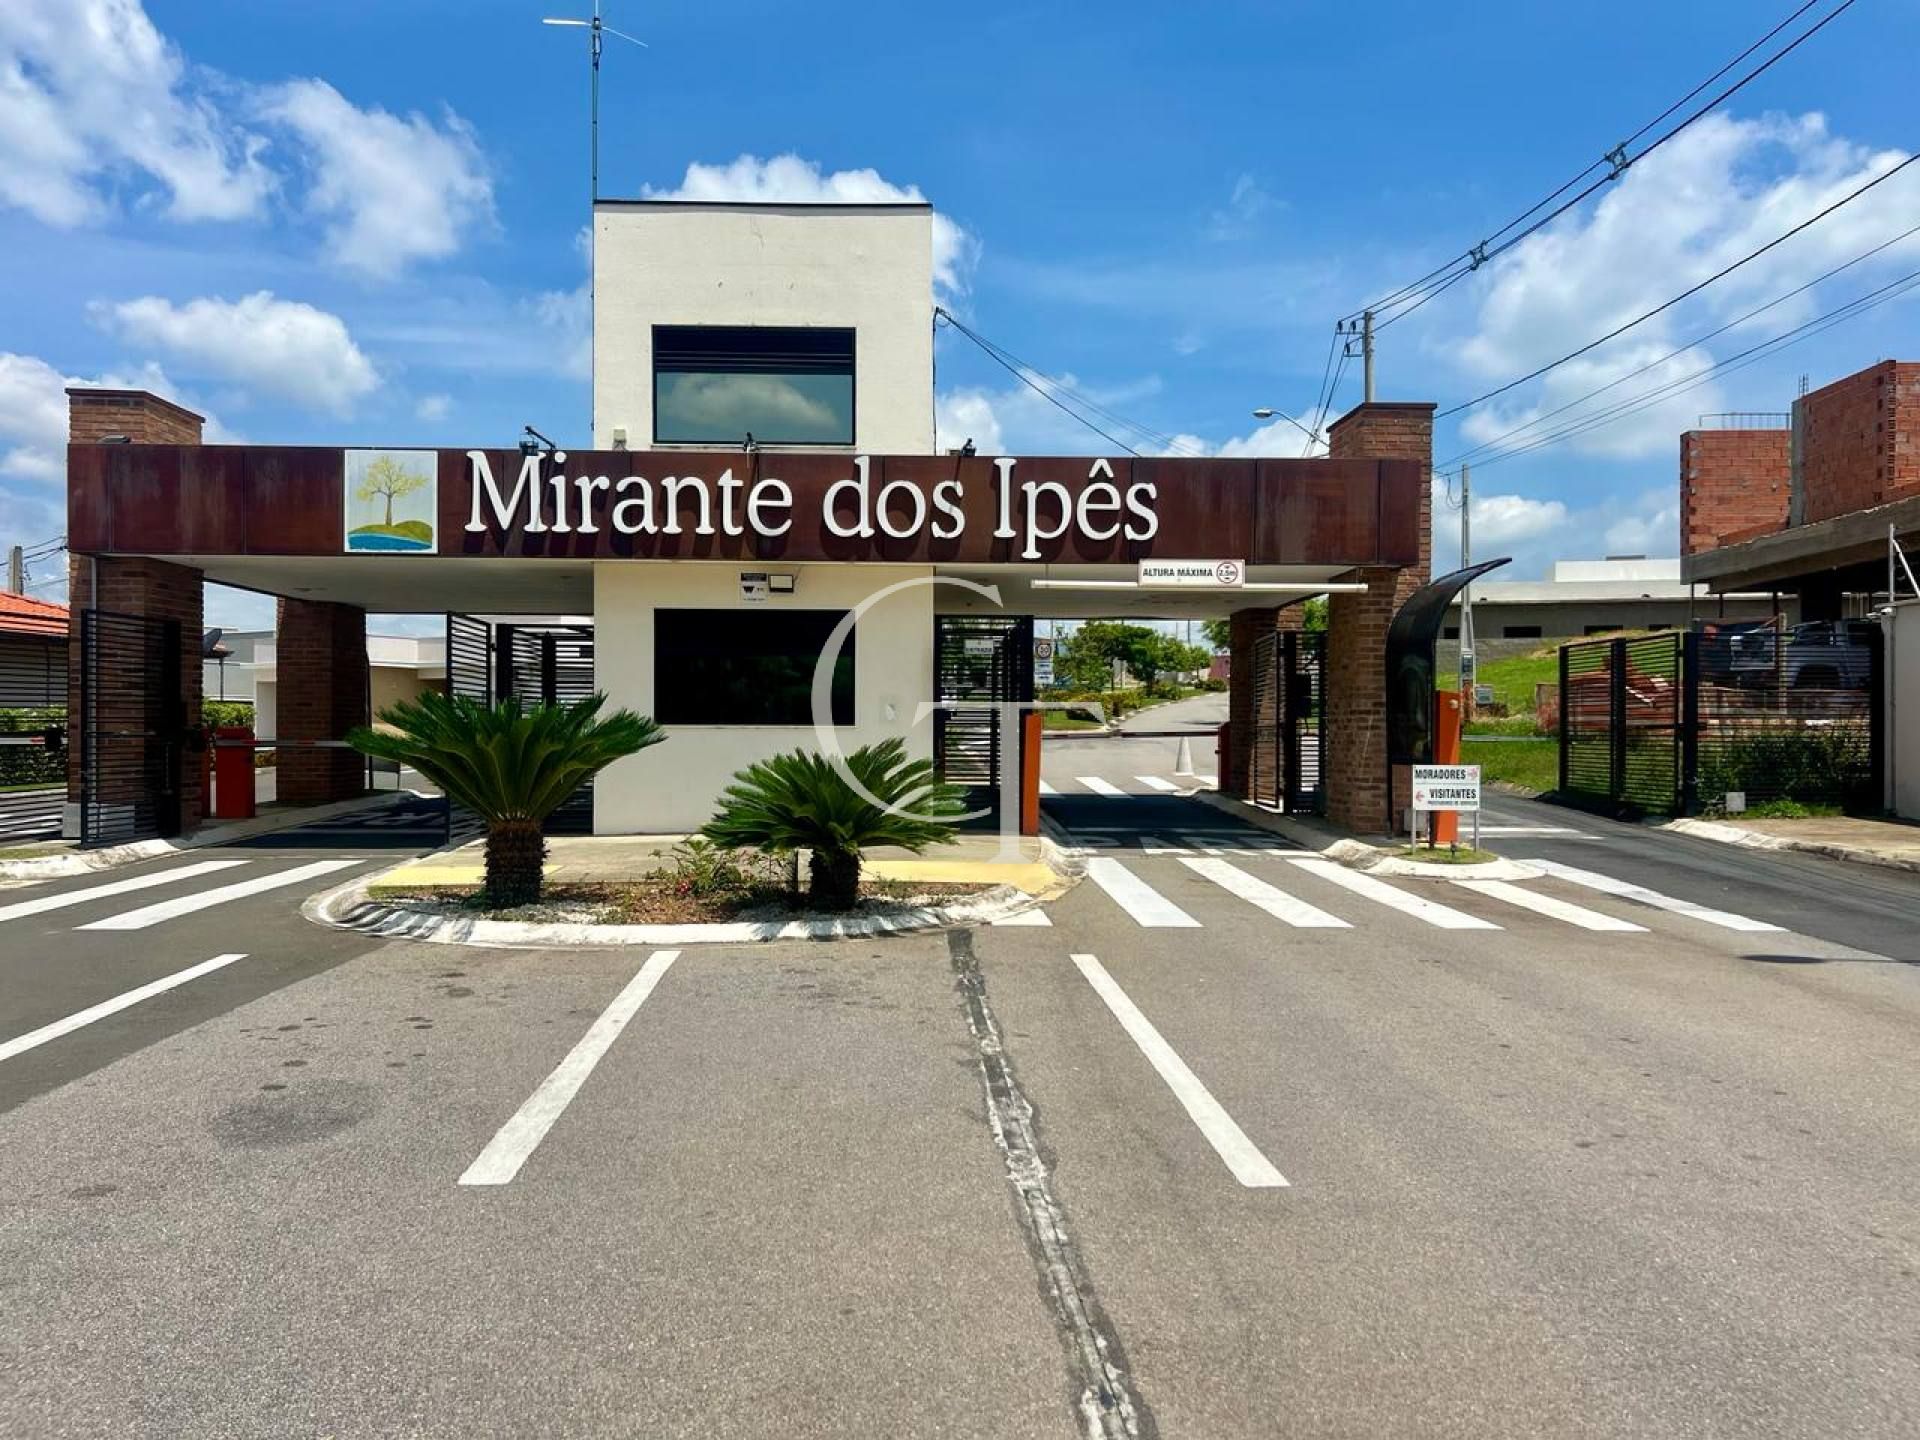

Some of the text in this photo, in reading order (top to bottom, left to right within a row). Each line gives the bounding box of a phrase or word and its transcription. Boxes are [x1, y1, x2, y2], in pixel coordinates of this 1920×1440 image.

[464, 451, 1159, 559] Mirante dos Ipês
[1143, 568, 1175, 577] ALTURA
[1177, 567, 1213, 577] MÁXIMA
[1415, 769, 1466, 779] MORADORES
[1430, 788, 1477, 798] VISITANTES
